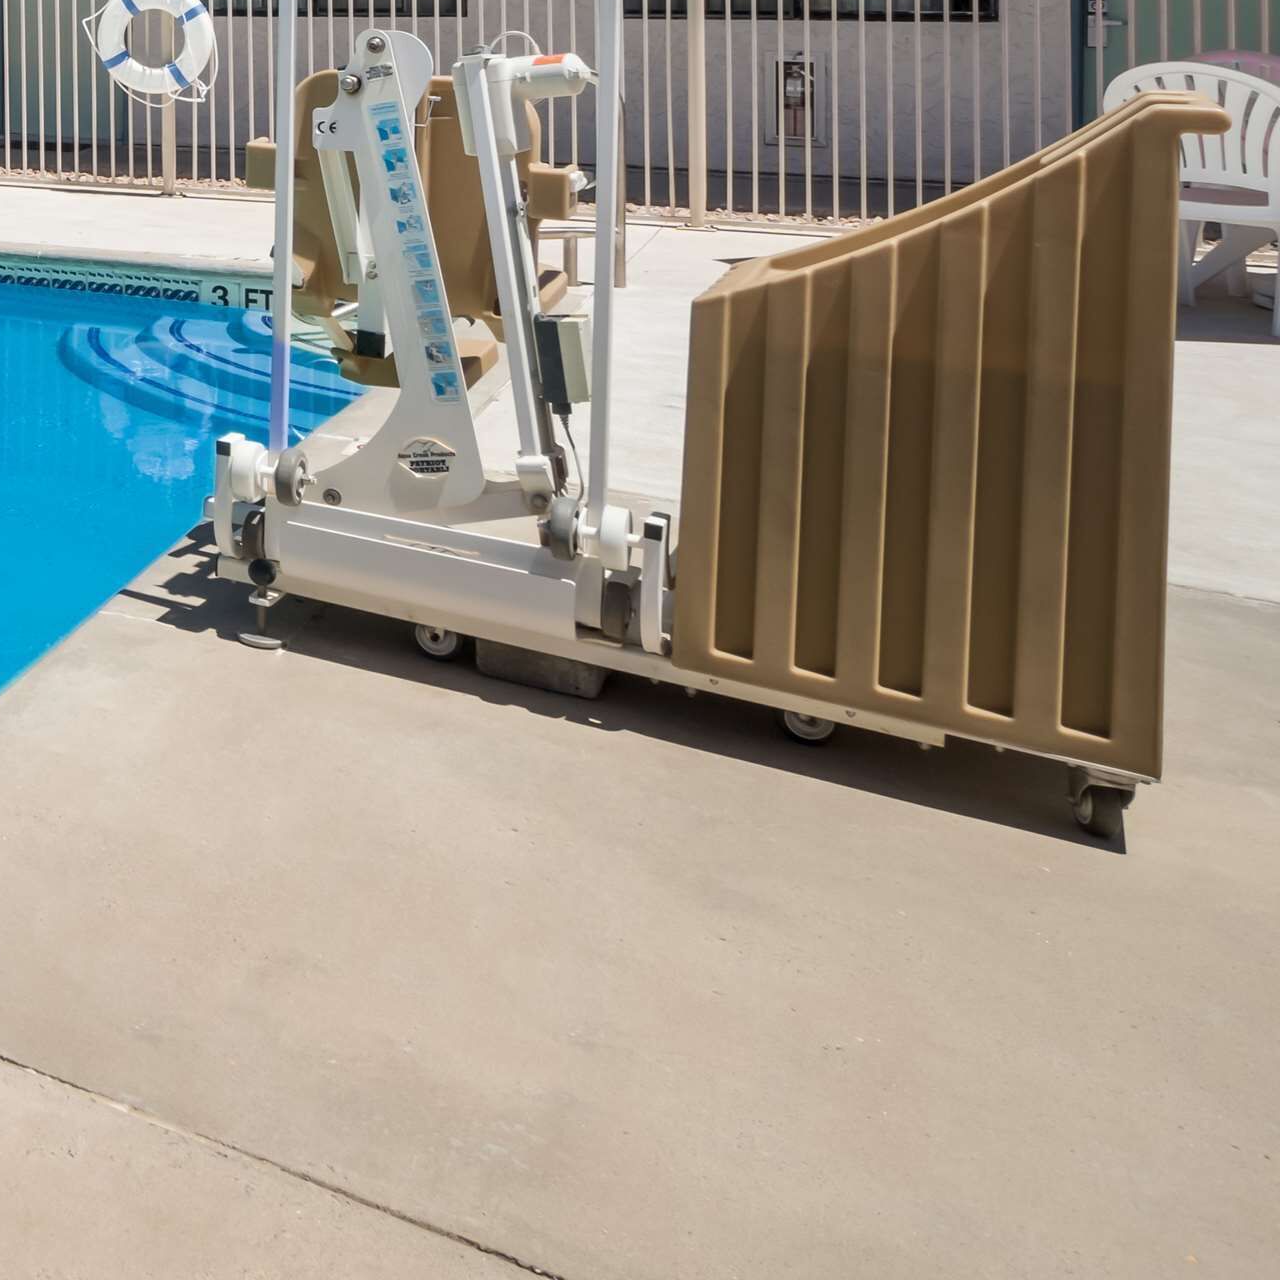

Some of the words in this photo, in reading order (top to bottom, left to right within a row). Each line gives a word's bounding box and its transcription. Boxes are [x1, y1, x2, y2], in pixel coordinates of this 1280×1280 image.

[317, 121, 337, 134] CE
[211, 285, 229, 306] 3
[244, 288, 274, 311] FT
